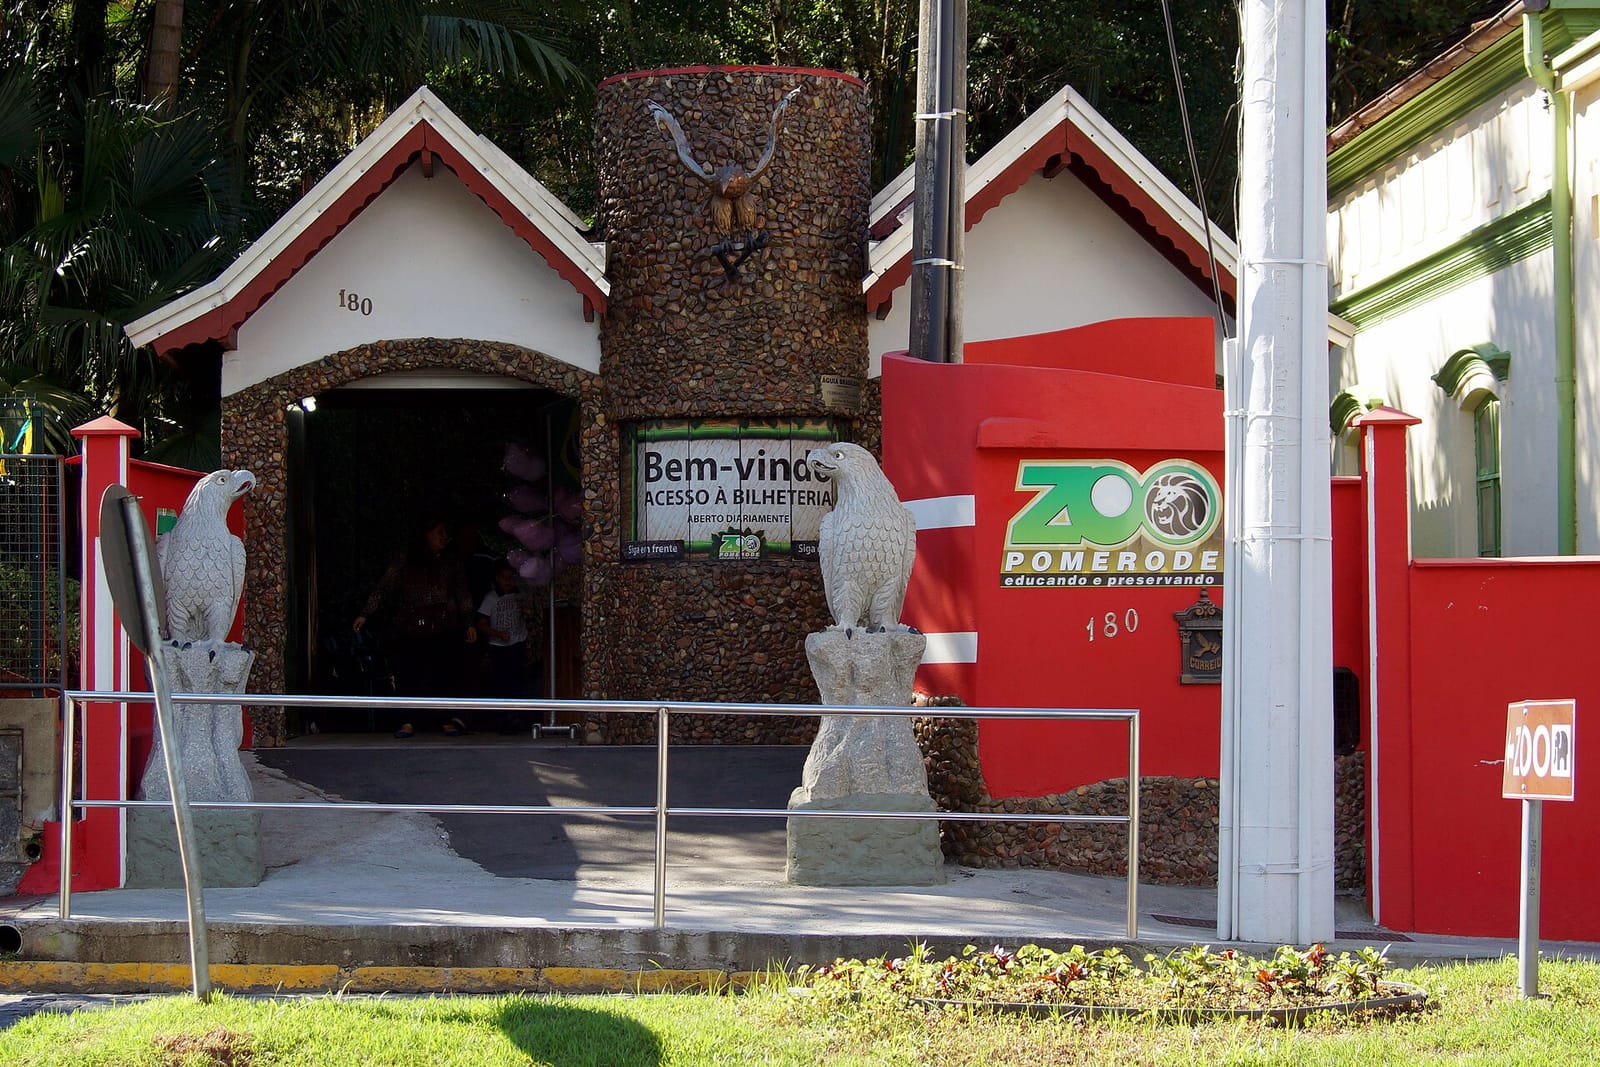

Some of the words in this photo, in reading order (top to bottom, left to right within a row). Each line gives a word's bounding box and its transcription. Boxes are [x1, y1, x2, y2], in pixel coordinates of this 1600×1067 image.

[339, 289, 373, 316] 180
[644, 489, 710, 506] ACESSO
[714, 486, 728, 505] À
[733, 489, 833, 506] BILHETERIA
[1007, 462, 1220, 549] ZOO
[687, 514, 724, 524] ABERTO
[726, 514, 790, 524] DIARIAMENTE
[628, 544, 640, 556] Siga
[652, 543, 678, 553] frente
[798, 543, 816, 555] Siga
[1004, 550, 1220, 572] POMERODE
[1004, 574, 1088, 586] educando
[1092, 576, 1102, 586] e
[1107, 574, 1216, 587] preservando
[1086, 608, 1139, 641] 180
[1512, 724, 1551, 778] ZOO
